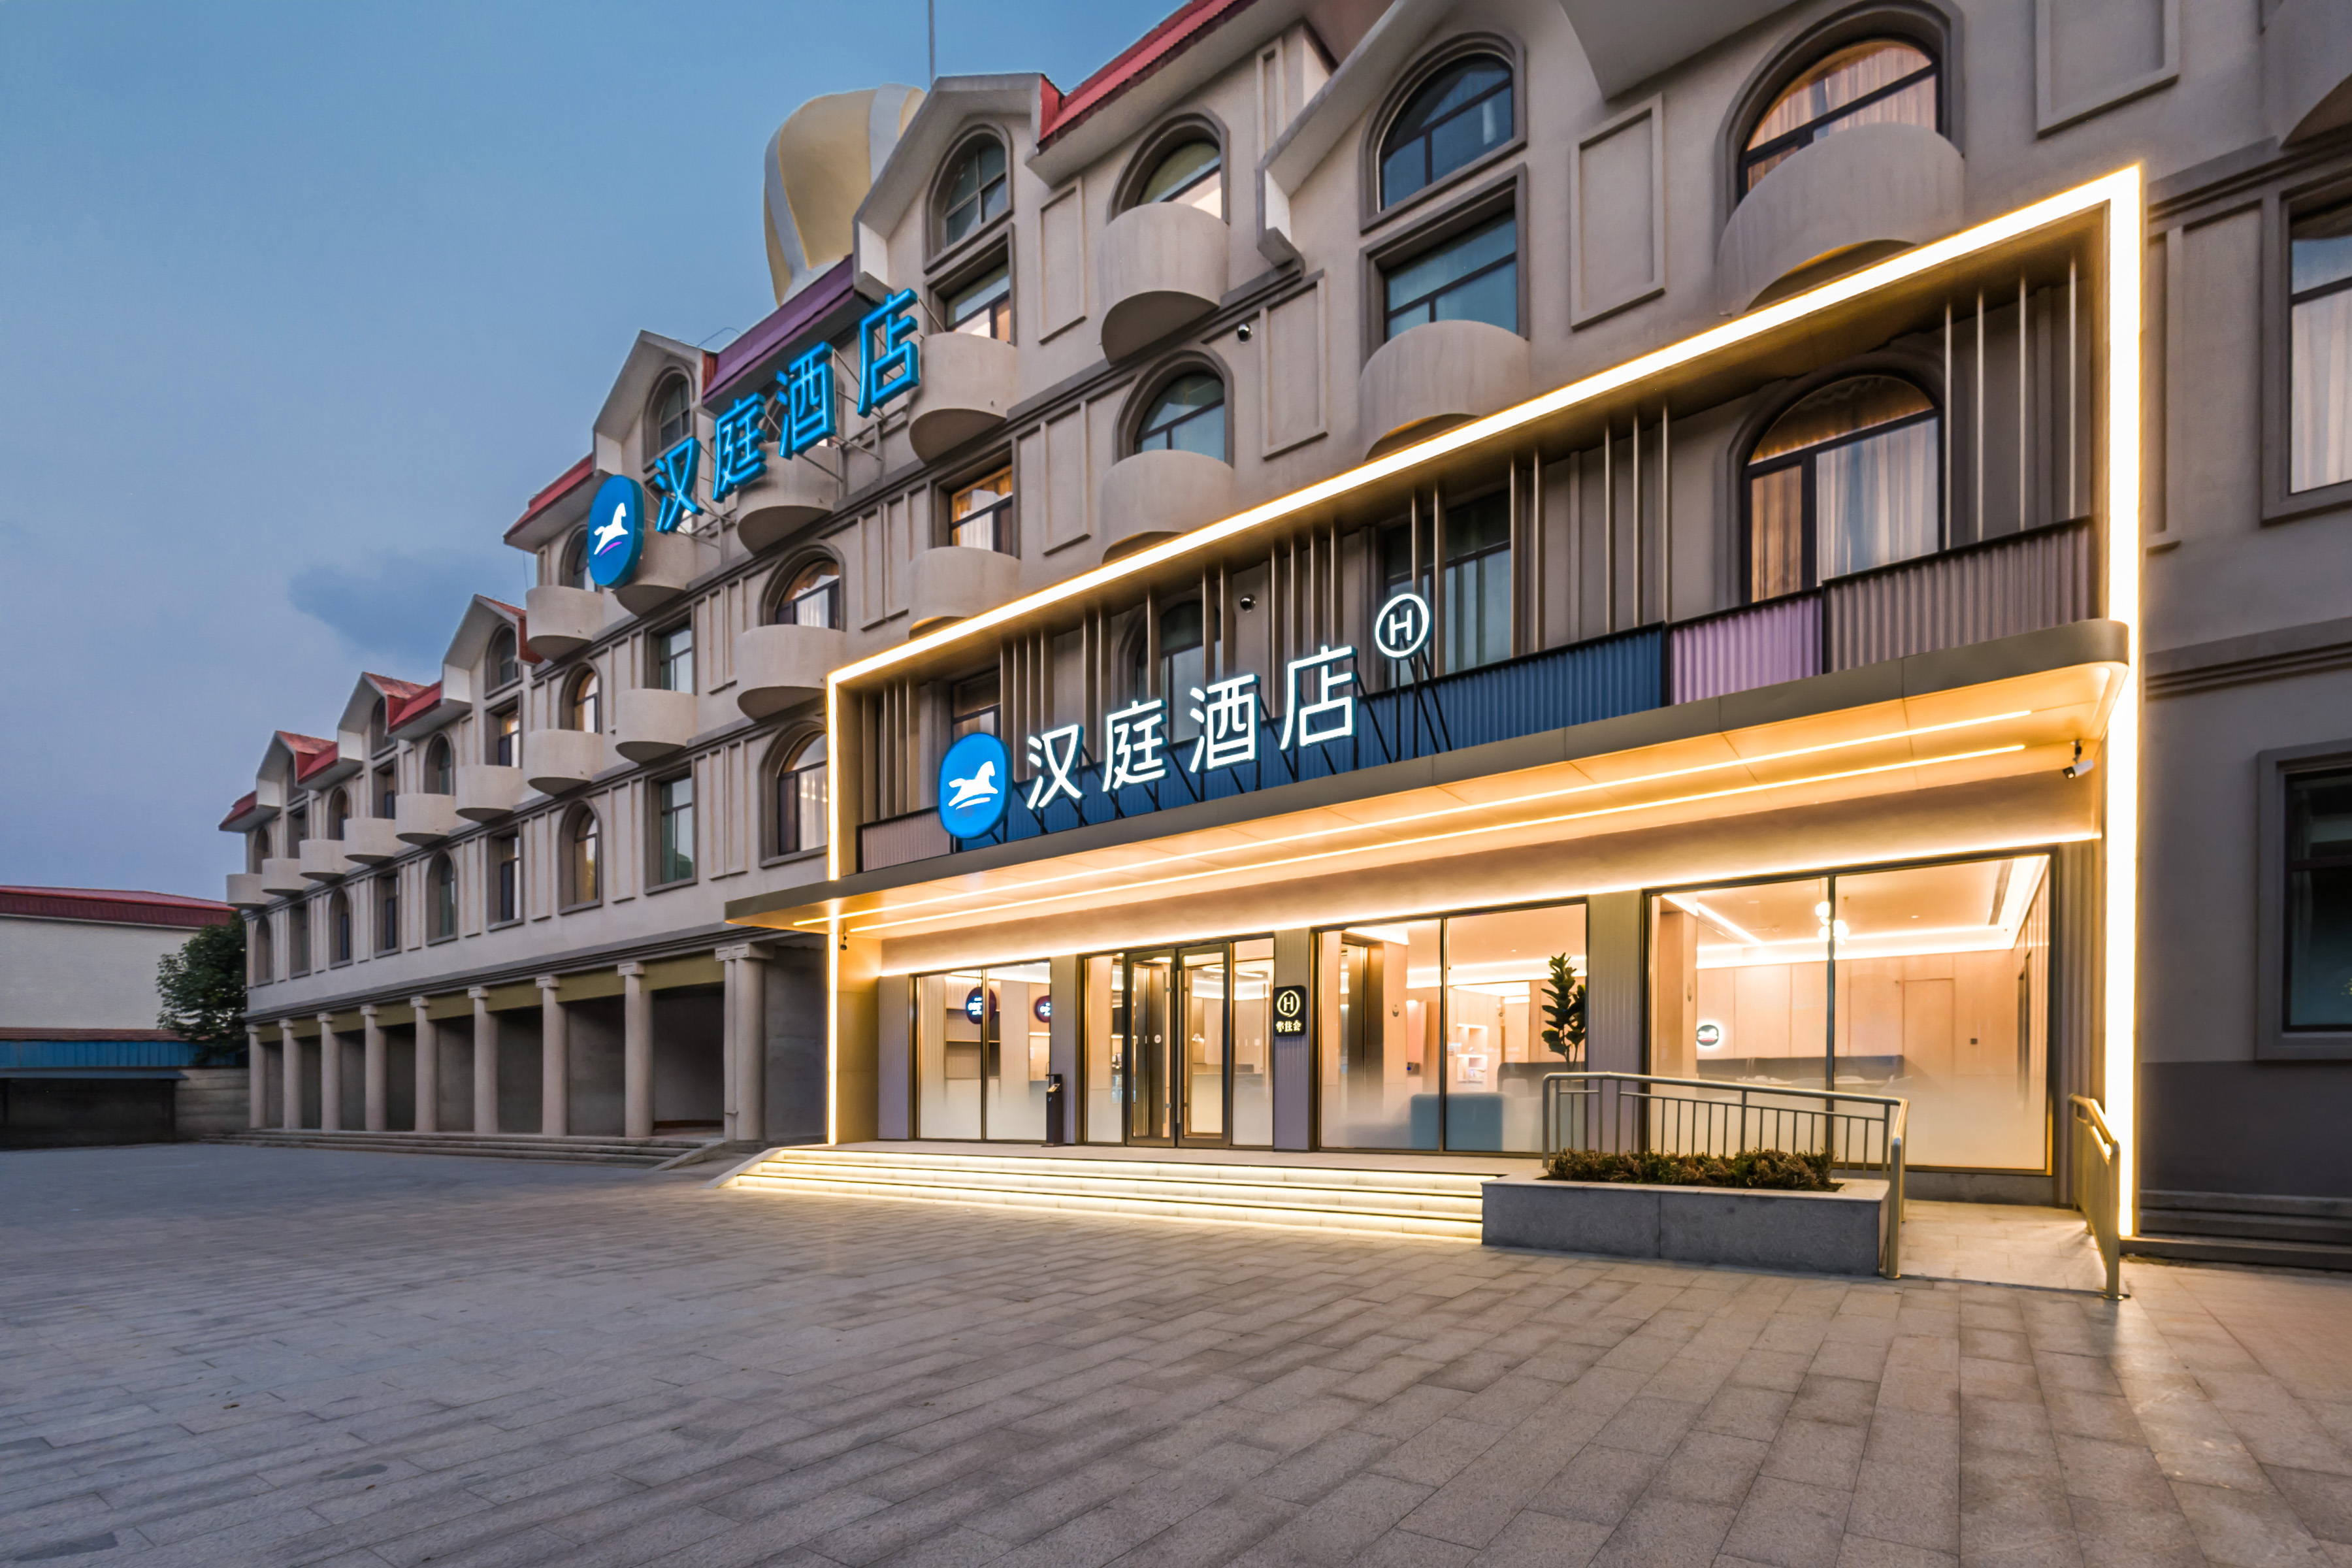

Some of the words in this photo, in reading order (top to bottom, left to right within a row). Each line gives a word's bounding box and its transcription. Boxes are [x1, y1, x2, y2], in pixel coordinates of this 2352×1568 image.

[654, 288, 920, 534] 汉庭酒店
[1026, 645, 1357, 810] 汉庭酒店
